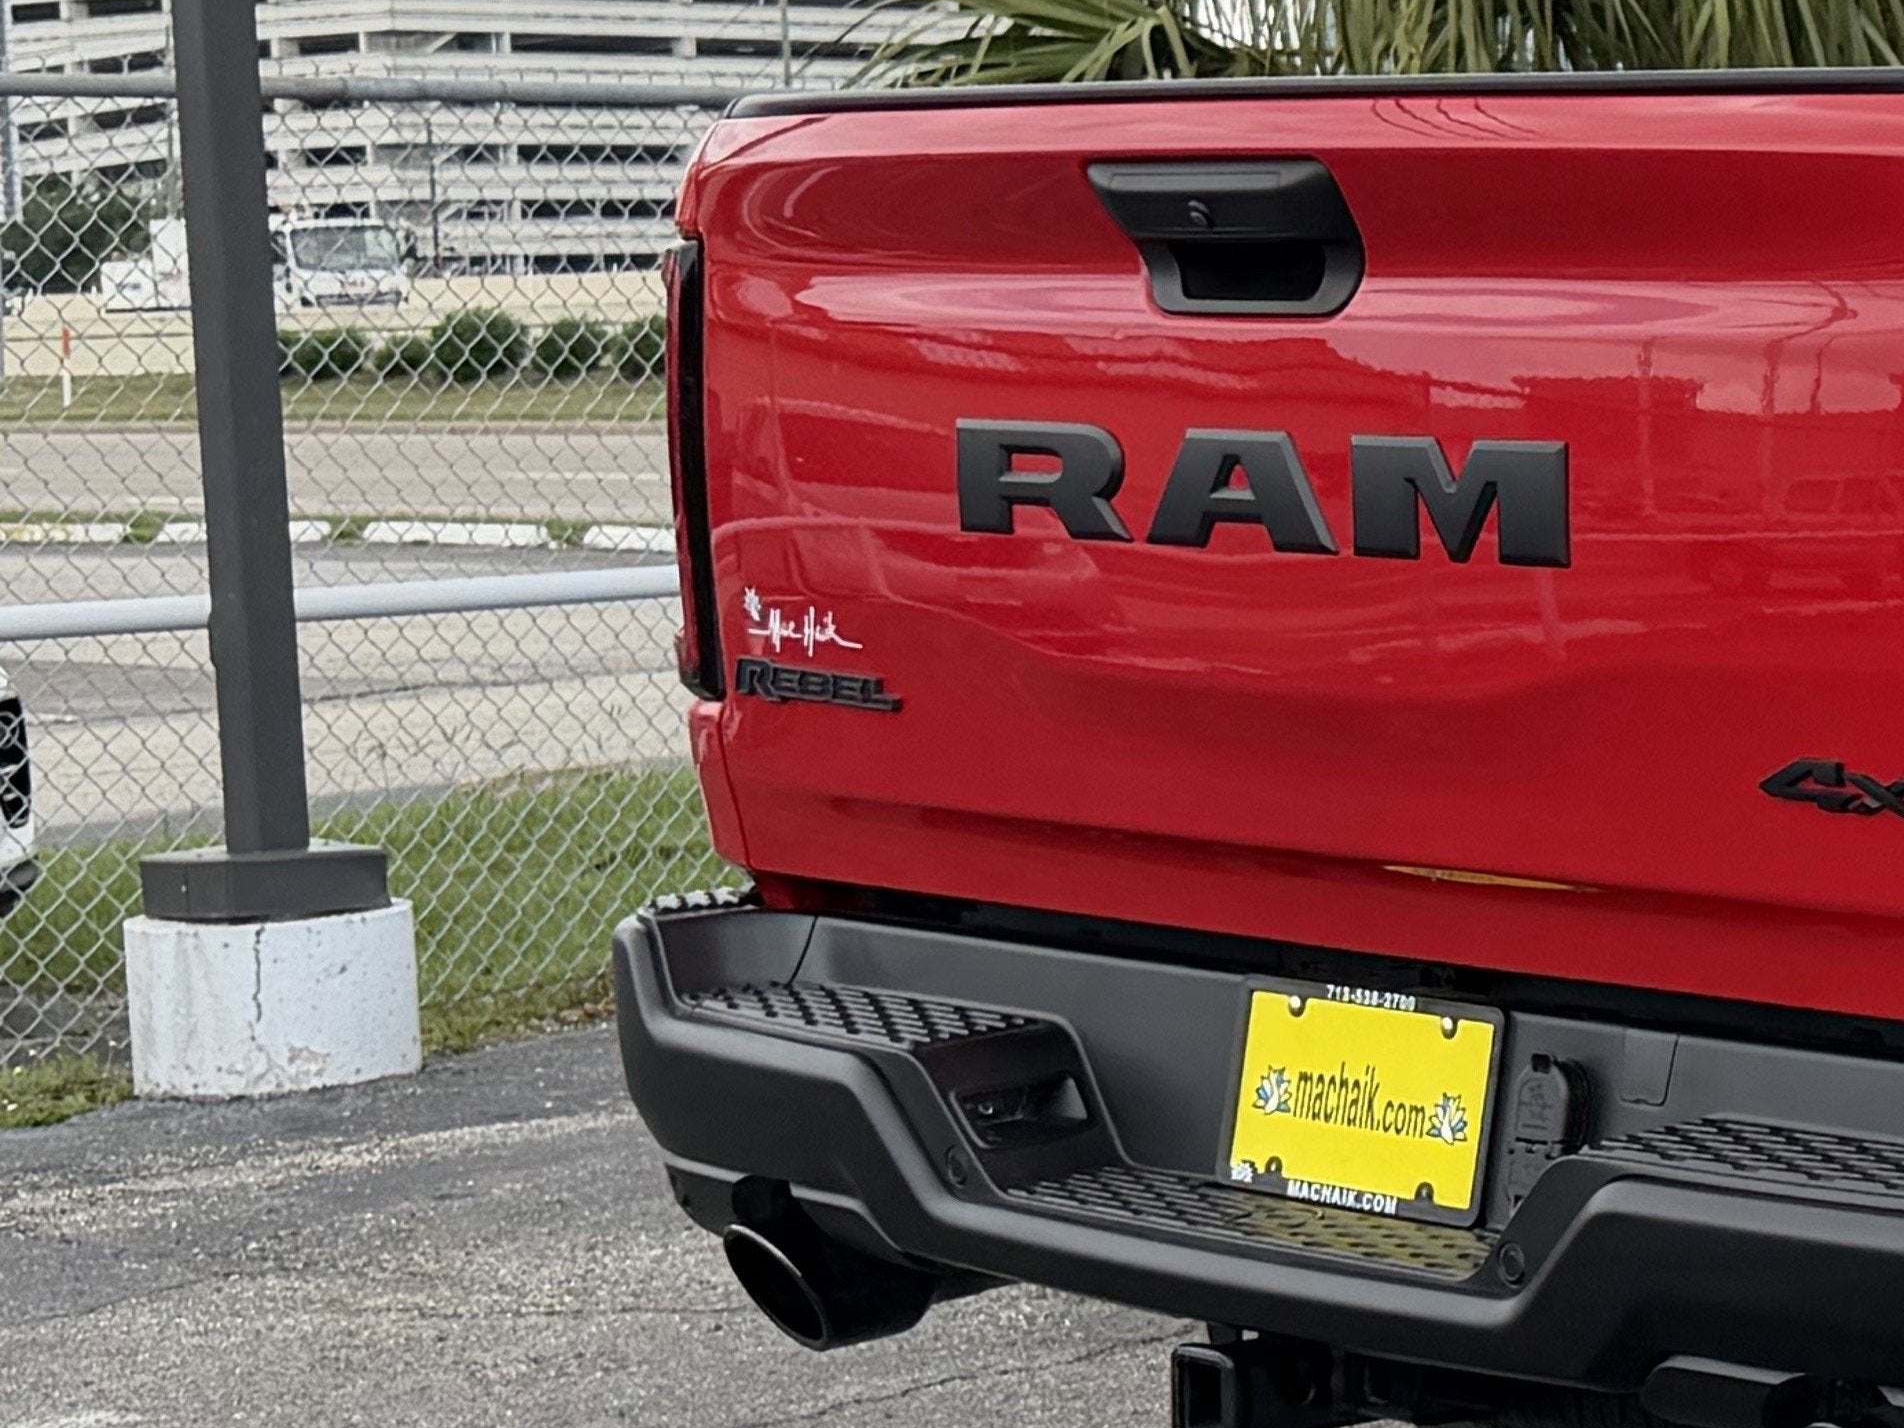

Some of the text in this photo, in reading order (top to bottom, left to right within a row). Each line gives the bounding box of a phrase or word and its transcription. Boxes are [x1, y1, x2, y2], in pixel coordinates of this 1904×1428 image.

[955, 416, 1573, 569] RAM
[736, 657, 904, 713] REBEL
[1292, 1060, 1426, 1139] machaik.com
[1286, 1179, 1398, 1215] MACHAIK.COM
